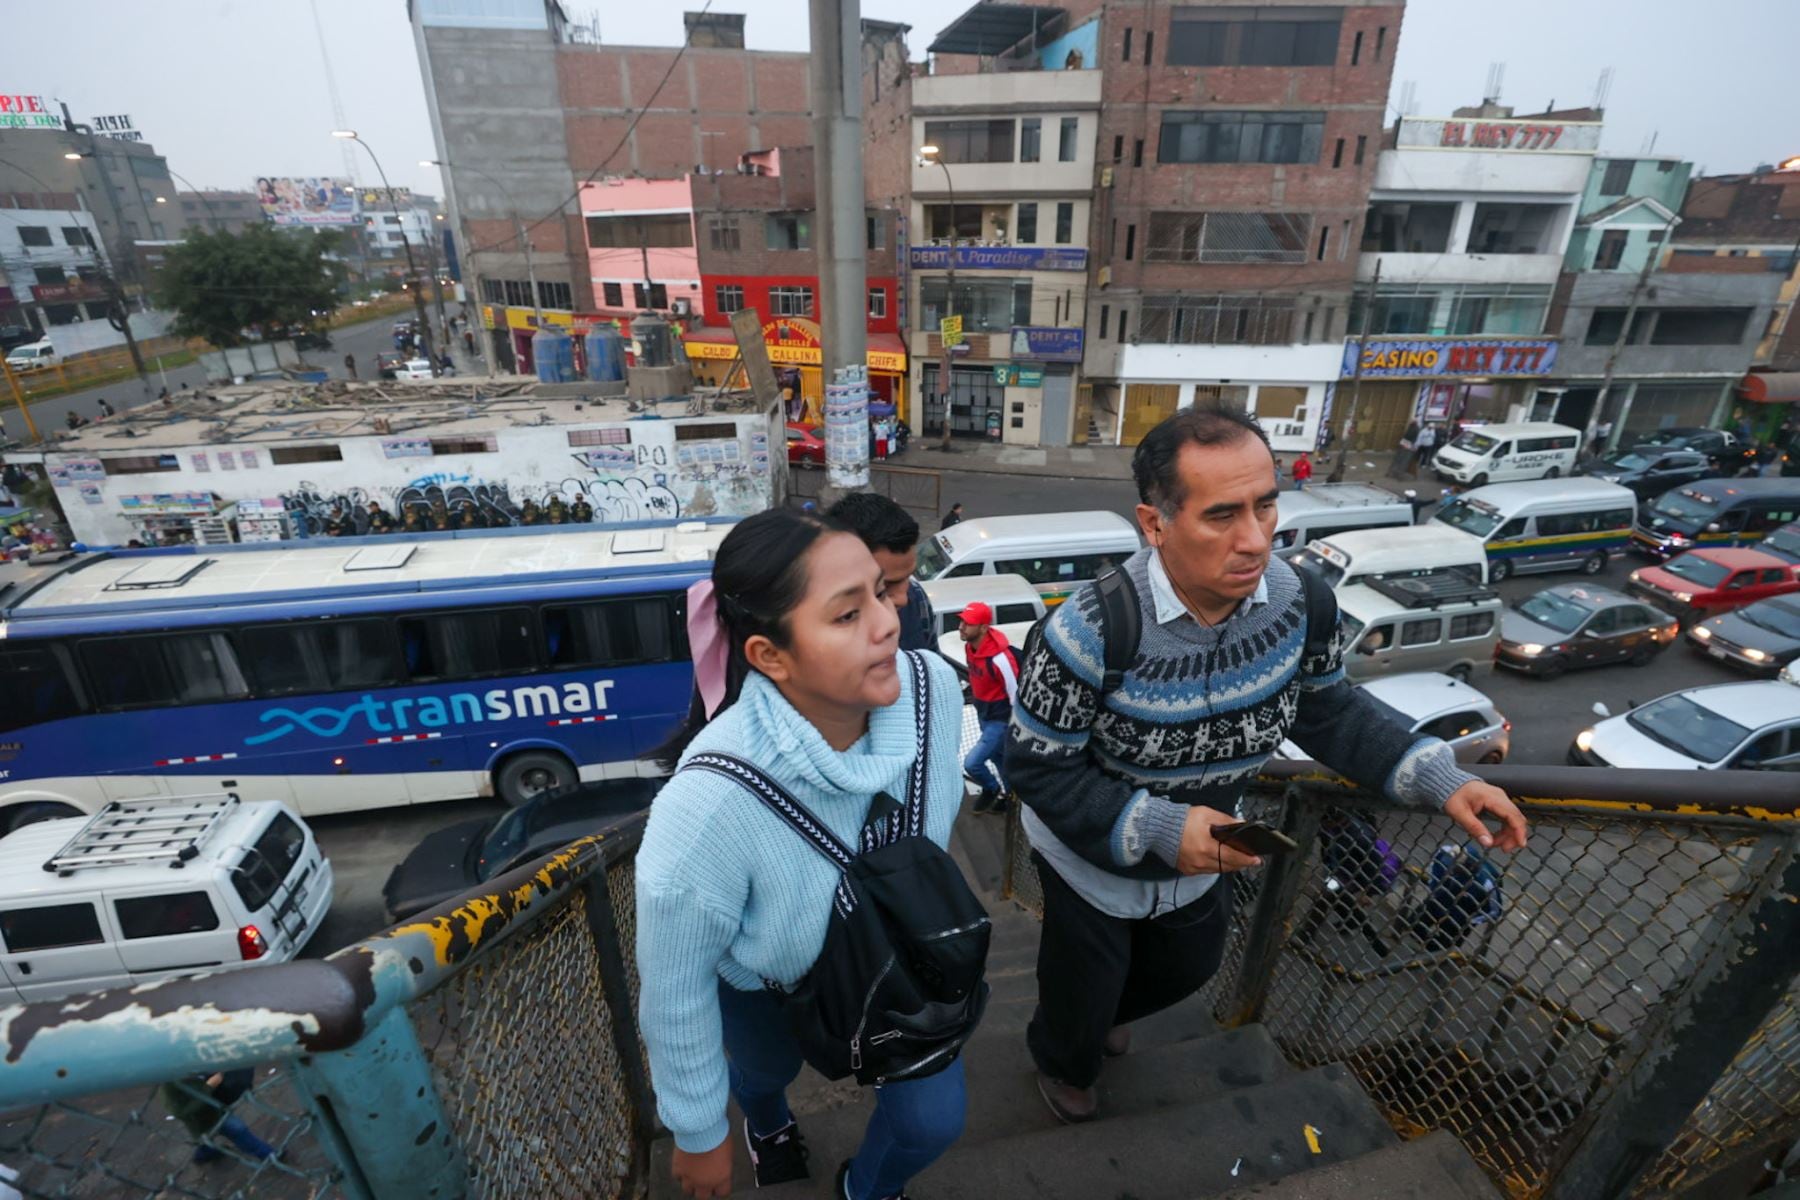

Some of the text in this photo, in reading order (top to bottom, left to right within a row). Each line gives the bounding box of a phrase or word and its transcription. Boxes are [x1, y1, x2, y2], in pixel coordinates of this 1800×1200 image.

[1440, 122, 1564, 149] EL REY 777
[968, 250, 1032, 265] Paradise
[1361, 346, 1550, 371] CASINO REY 777
[361, 679, 614, 732] transmar
